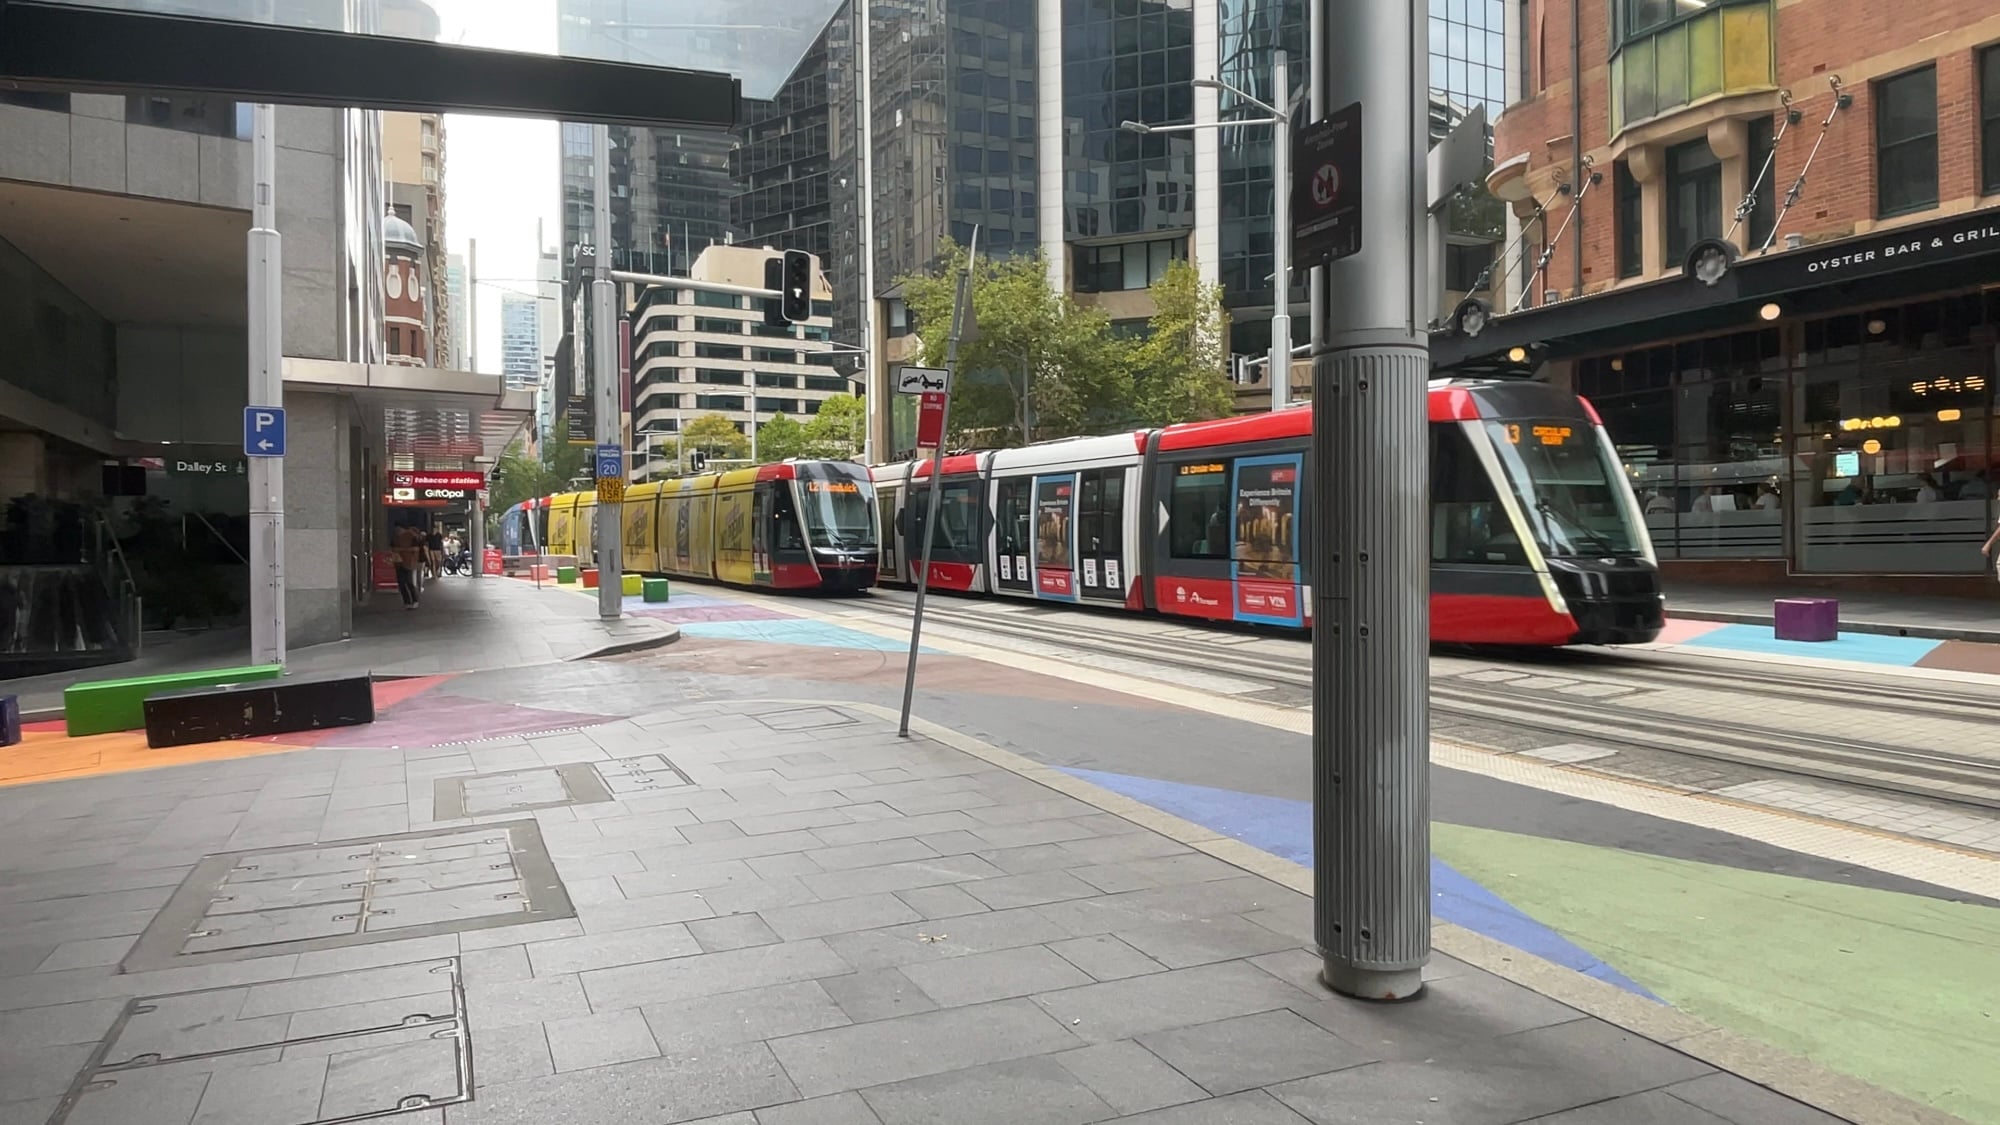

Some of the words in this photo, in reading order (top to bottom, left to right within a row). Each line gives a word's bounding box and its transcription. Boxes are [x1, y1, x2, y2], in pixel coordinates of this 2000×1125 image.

[1807, 250, 1876, 273] OYSTER
[1884, 241, 1922, 257] BAR
[1931, 237, 1943, 248] &
[255, 412, 275, 433] P
[176, 461, 212, 474] Dalley
[214, 462, 228, 473] St
[603, 464, 617, 475] 20
[414, 476, 448, 484] tobacco
[450, 476, 480, 484] station
[600, 480, 621, 490] END
